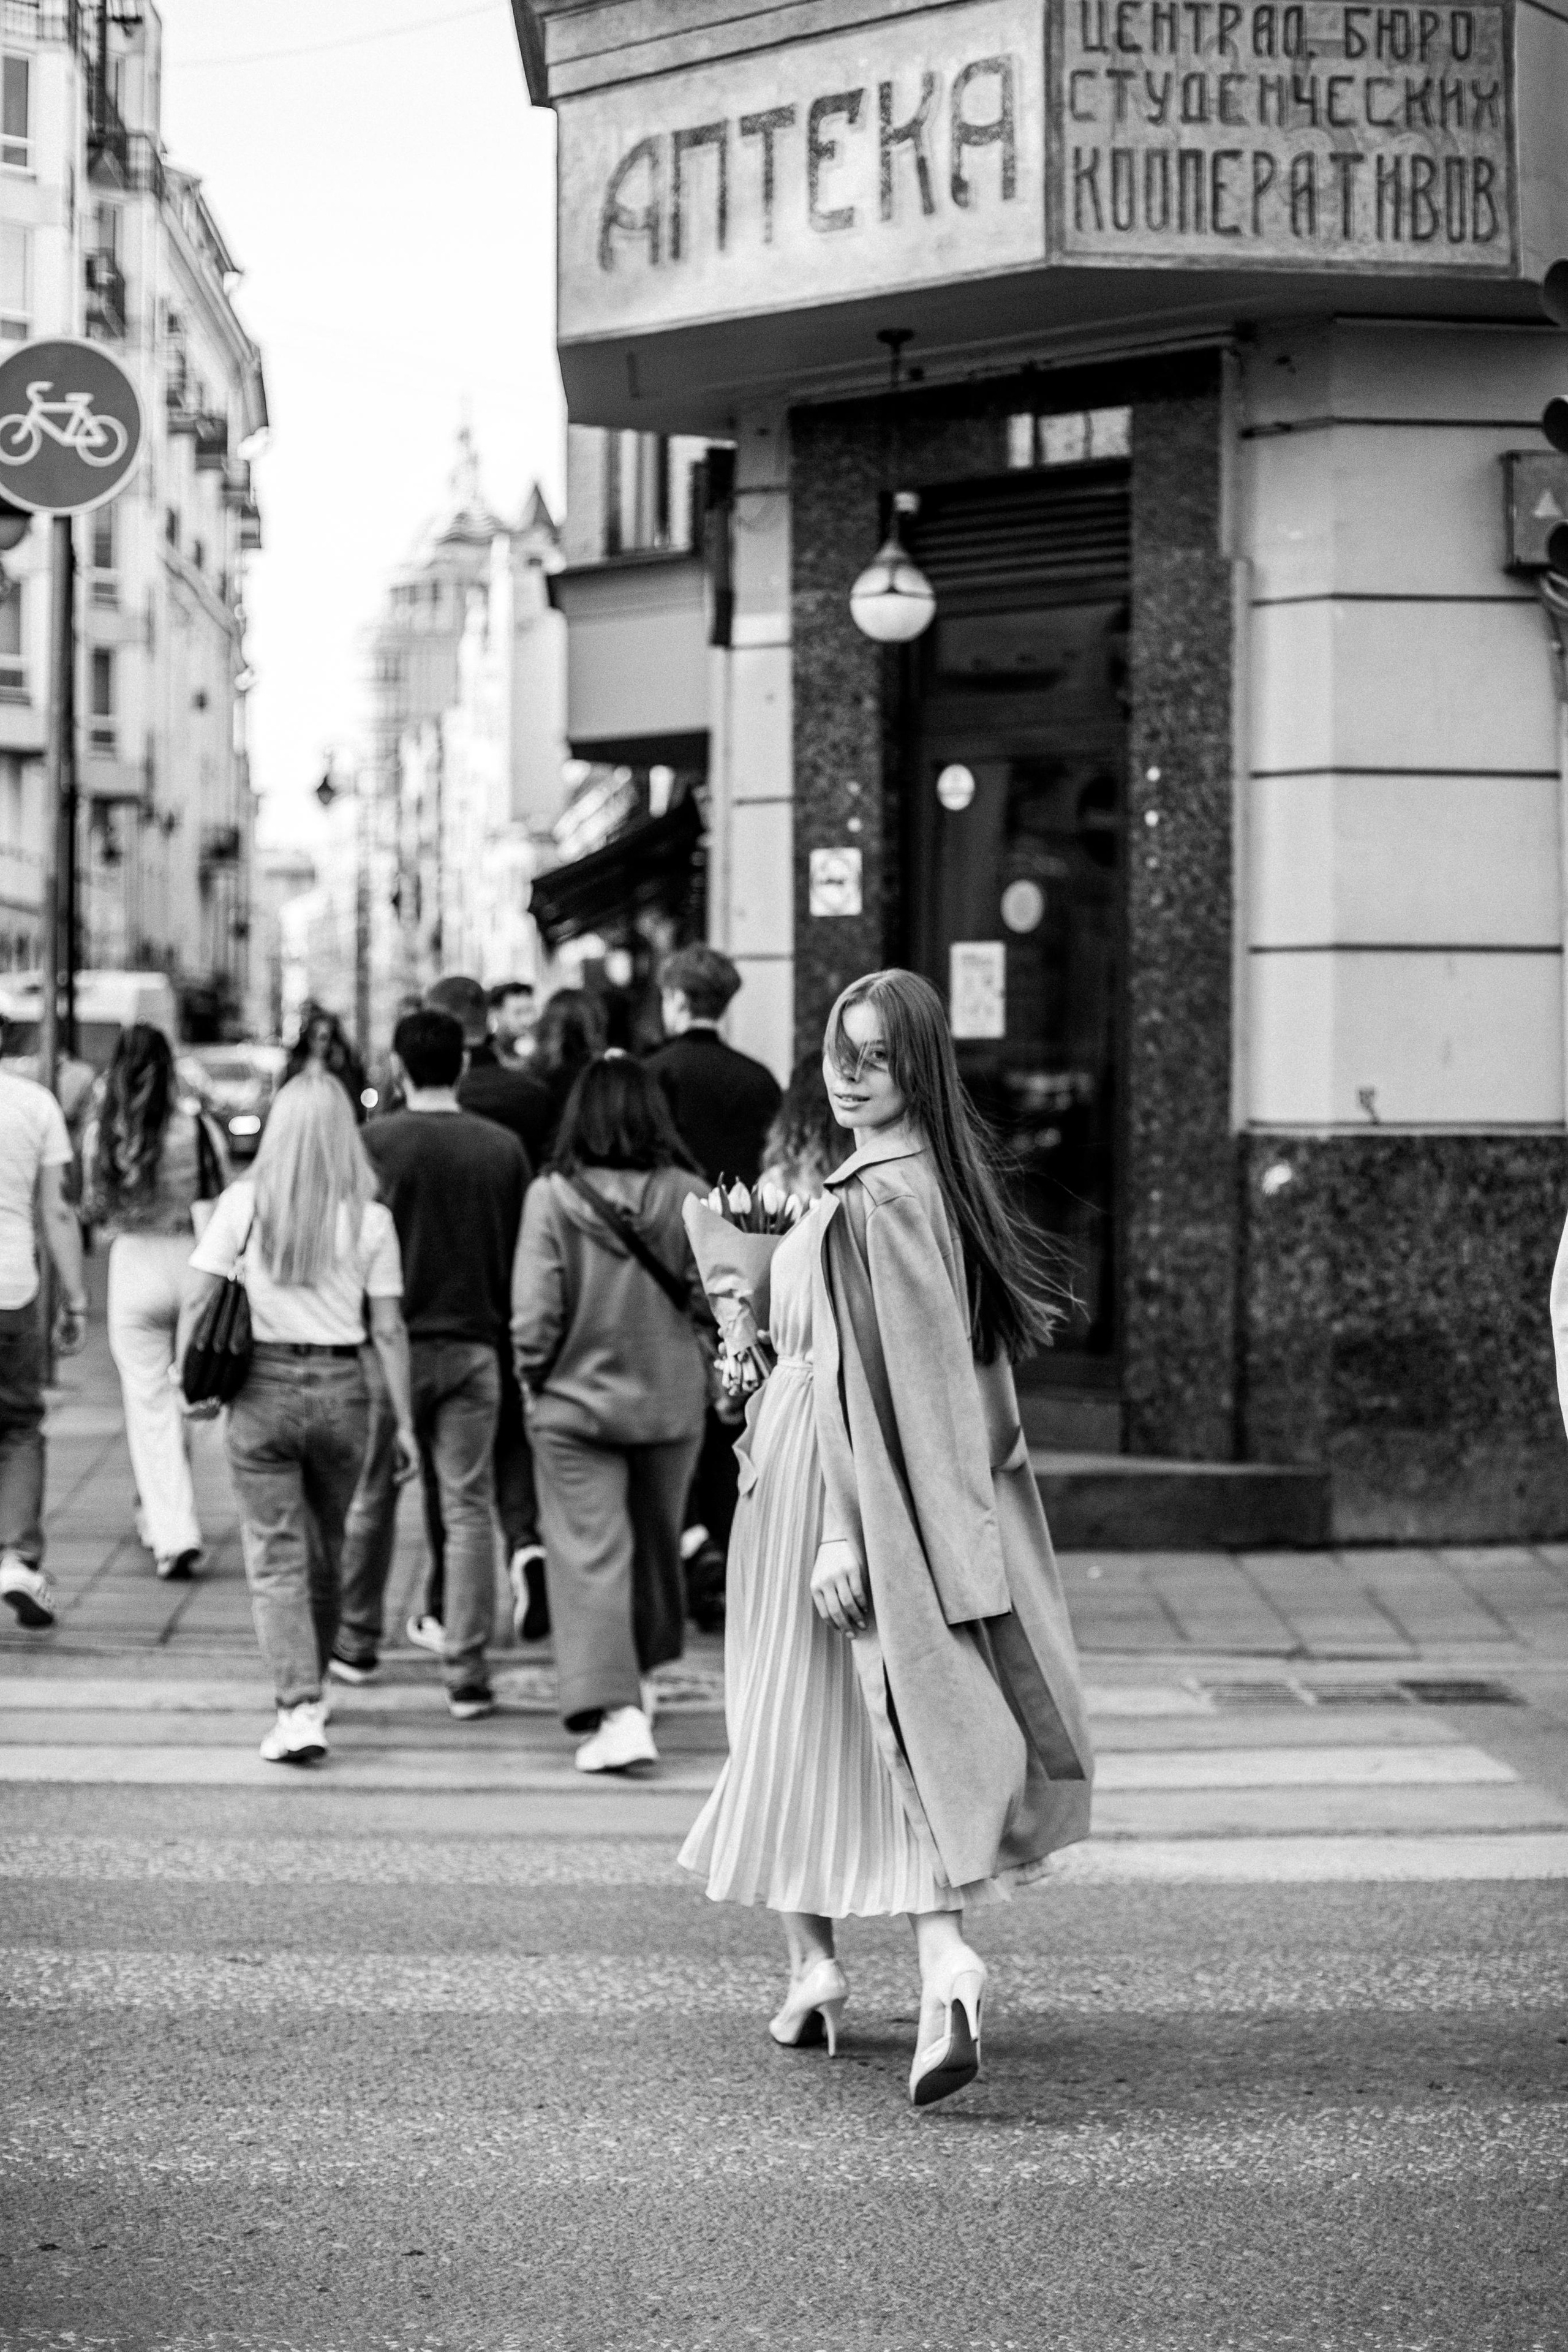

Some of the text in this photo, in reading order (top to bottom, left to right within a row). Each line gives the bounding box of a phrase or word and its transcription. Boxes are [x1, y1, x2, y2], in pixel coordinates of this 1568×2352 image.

[1344, 7, 1472, 61] БЮРО
[1070, 69, 1501, 129] СТУДЕНЧЕСКИХ
[598, 51, 1017, 273] АПТЕКА
[1073, 145, 1499, 244] КООПЕРАТИВОВ
